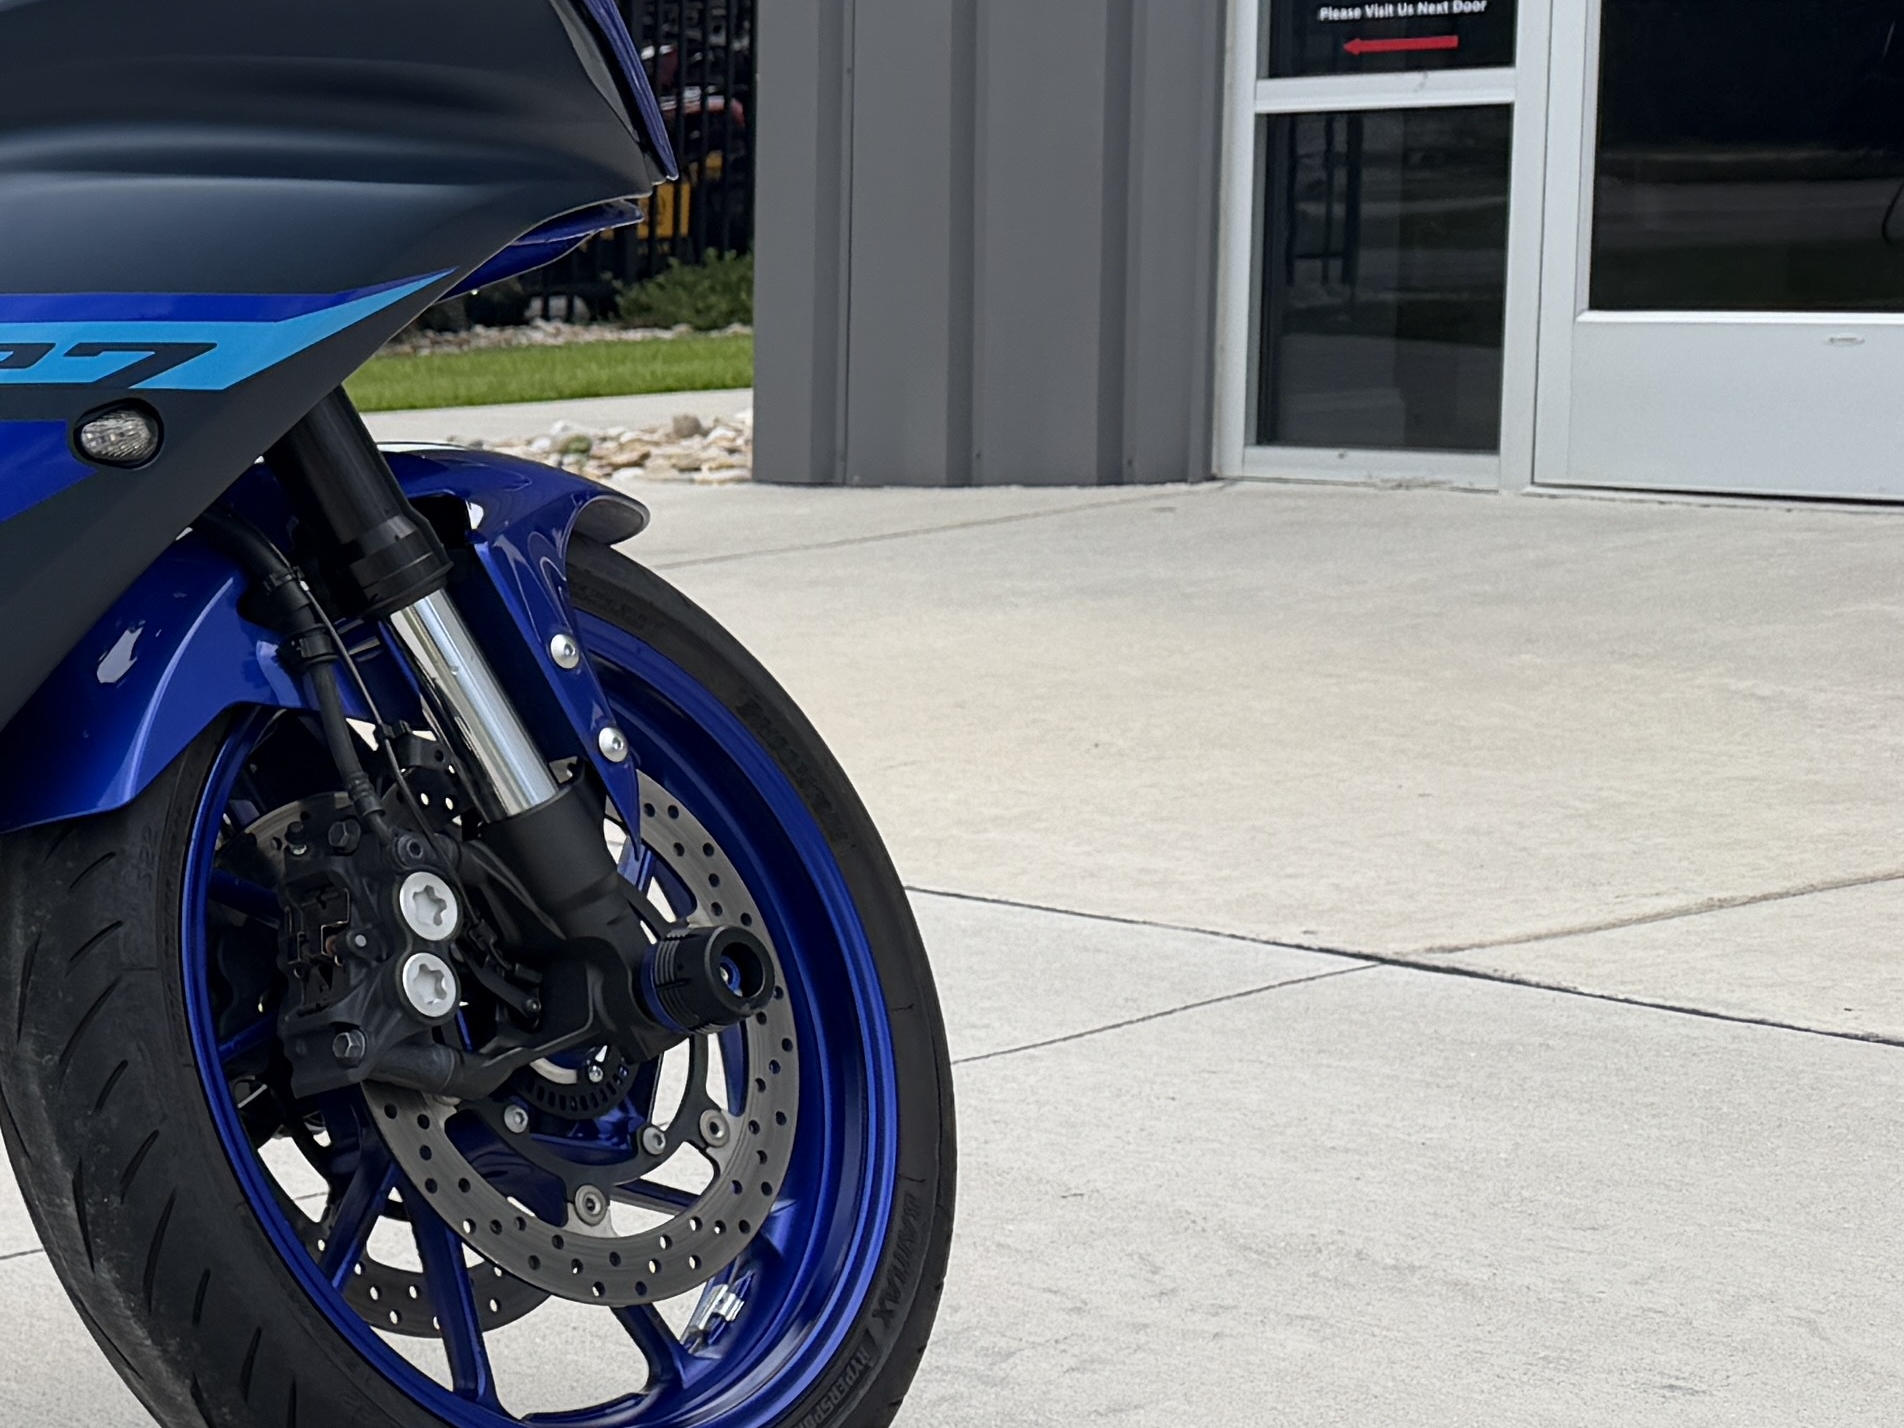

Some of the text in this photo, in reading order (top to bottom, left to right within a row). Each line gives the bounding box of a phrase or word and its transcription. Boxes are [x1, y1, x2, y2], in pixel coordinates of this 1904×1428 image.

[1318, 0, 1488, 21] Please Visit Us Next Door
